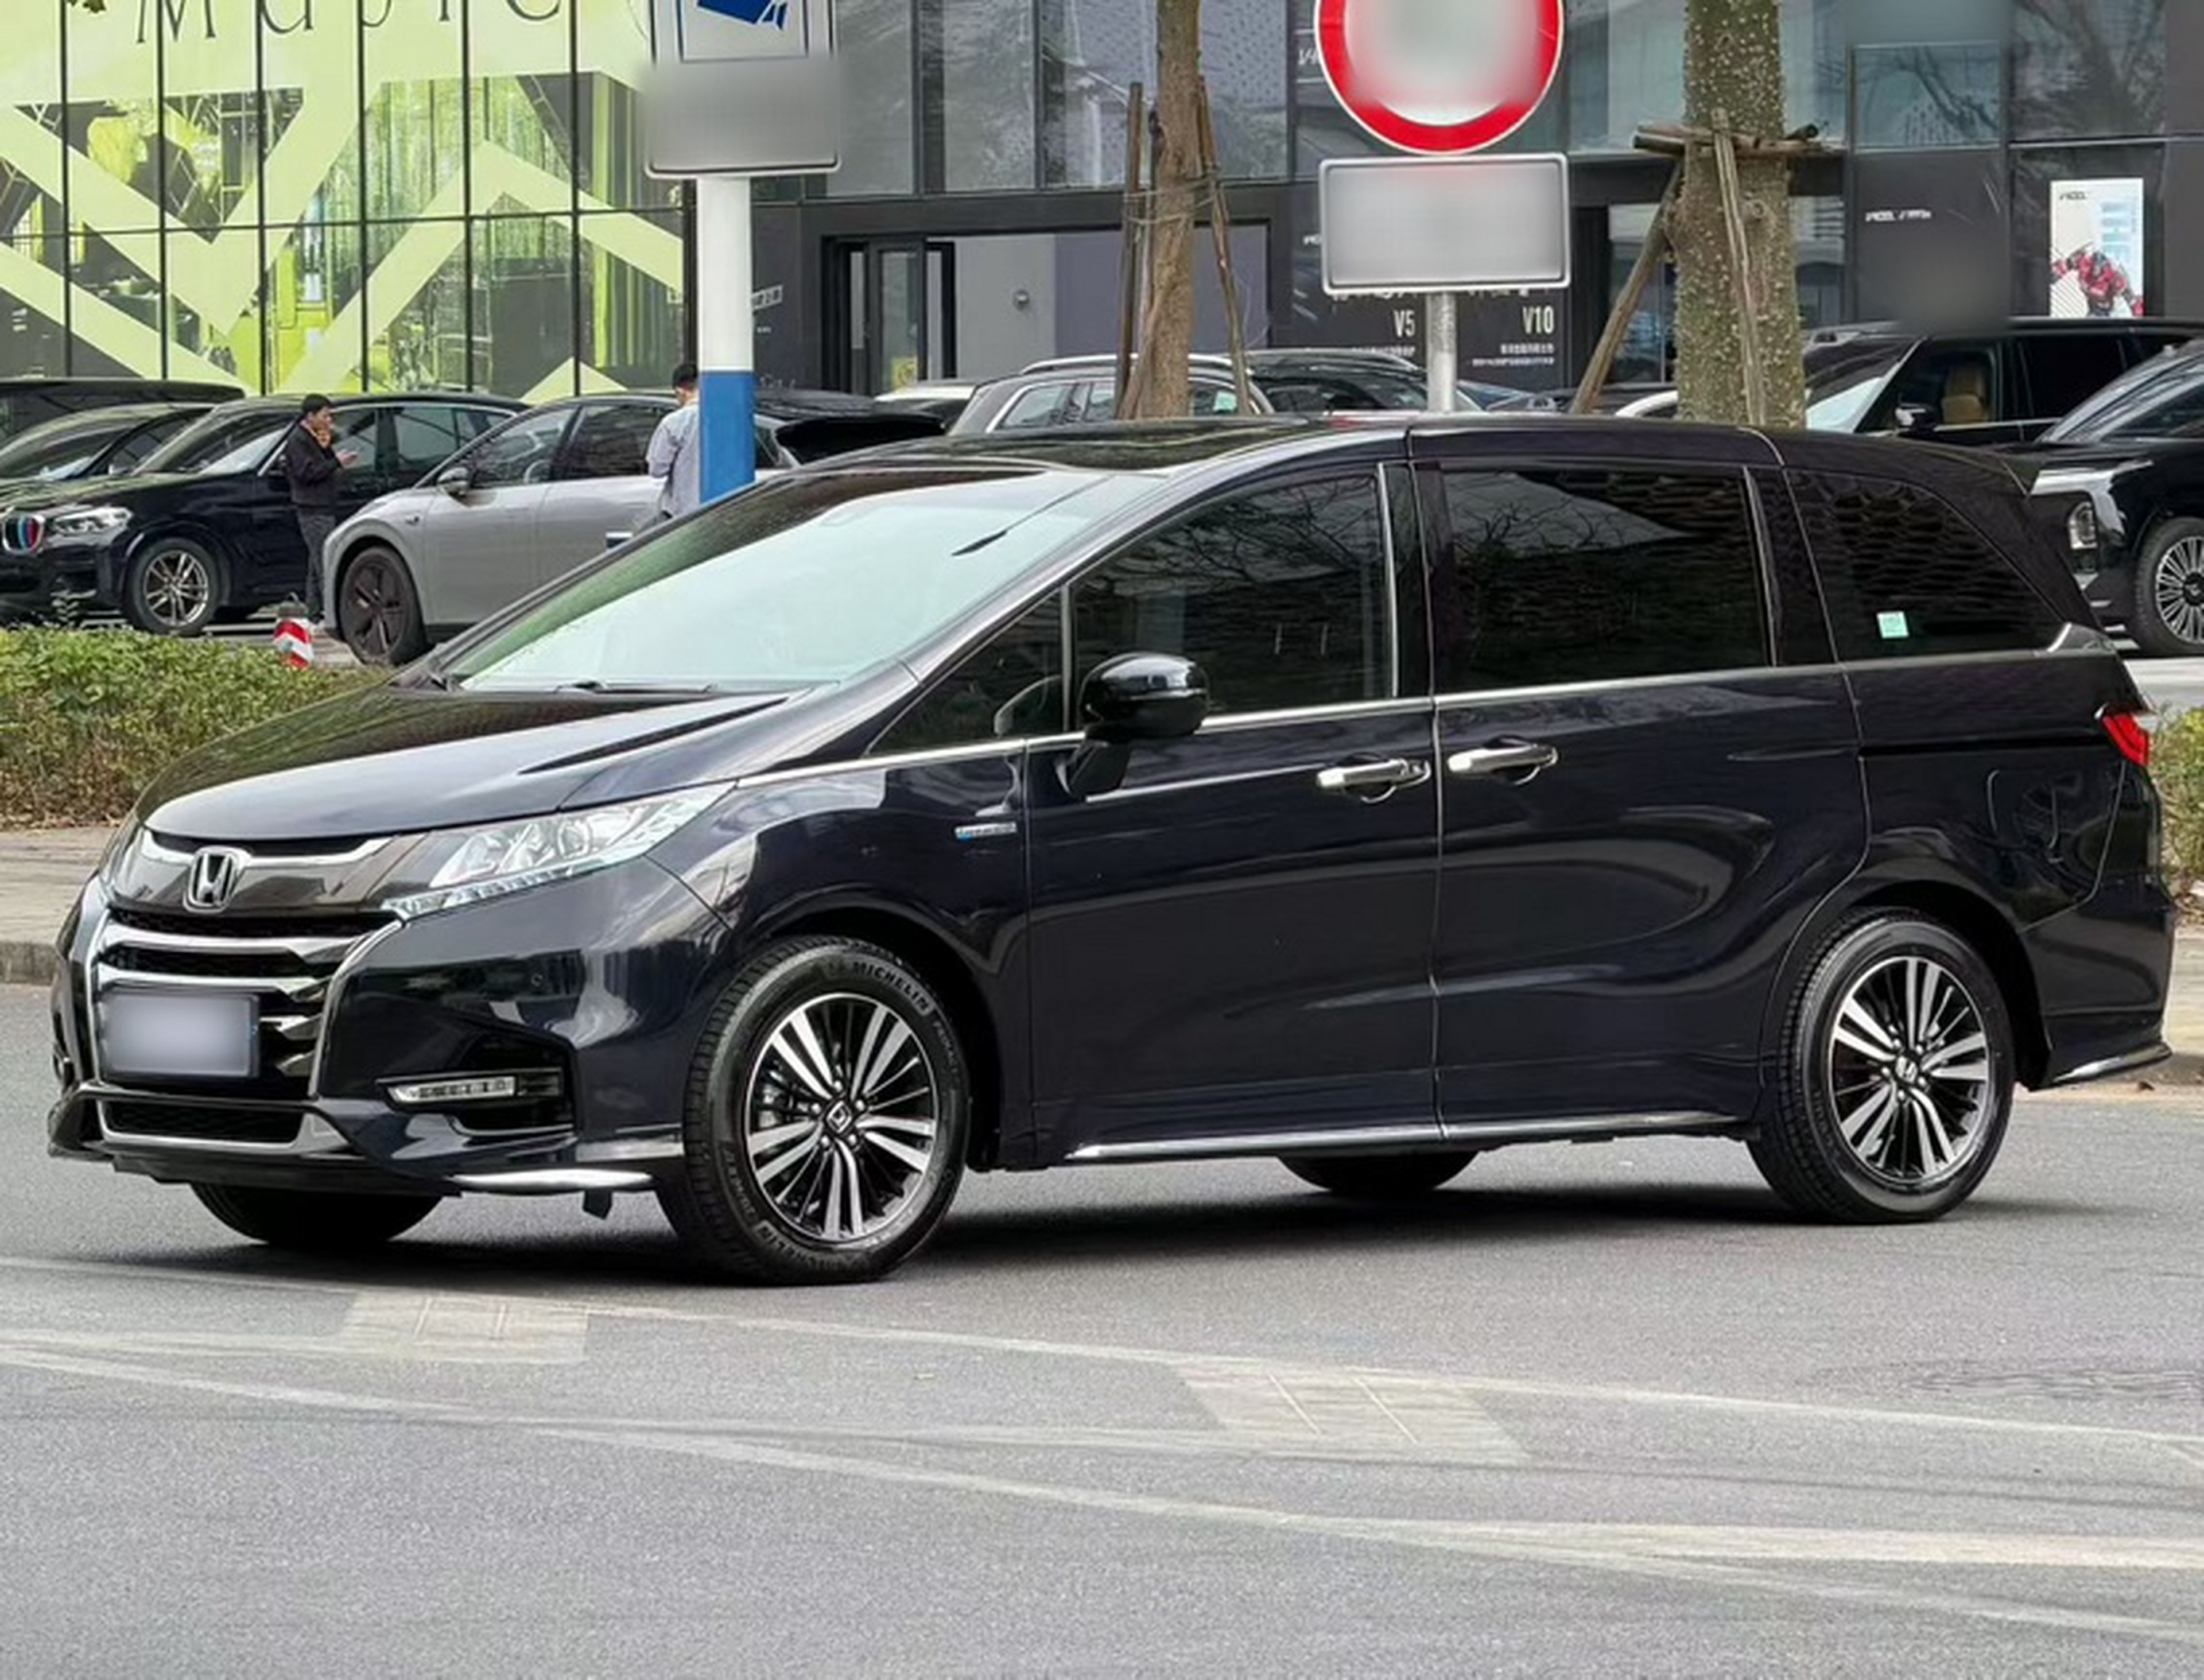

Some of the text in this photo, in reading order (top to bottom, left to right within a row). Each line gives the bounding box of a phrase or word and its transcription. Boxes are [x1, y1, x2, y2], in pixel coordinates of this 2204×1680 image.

[1393, 309, 1416, 337] V5
[1522, 305, 1555, 334] V10
[853, 961, 930, 1012] MICHELIN
